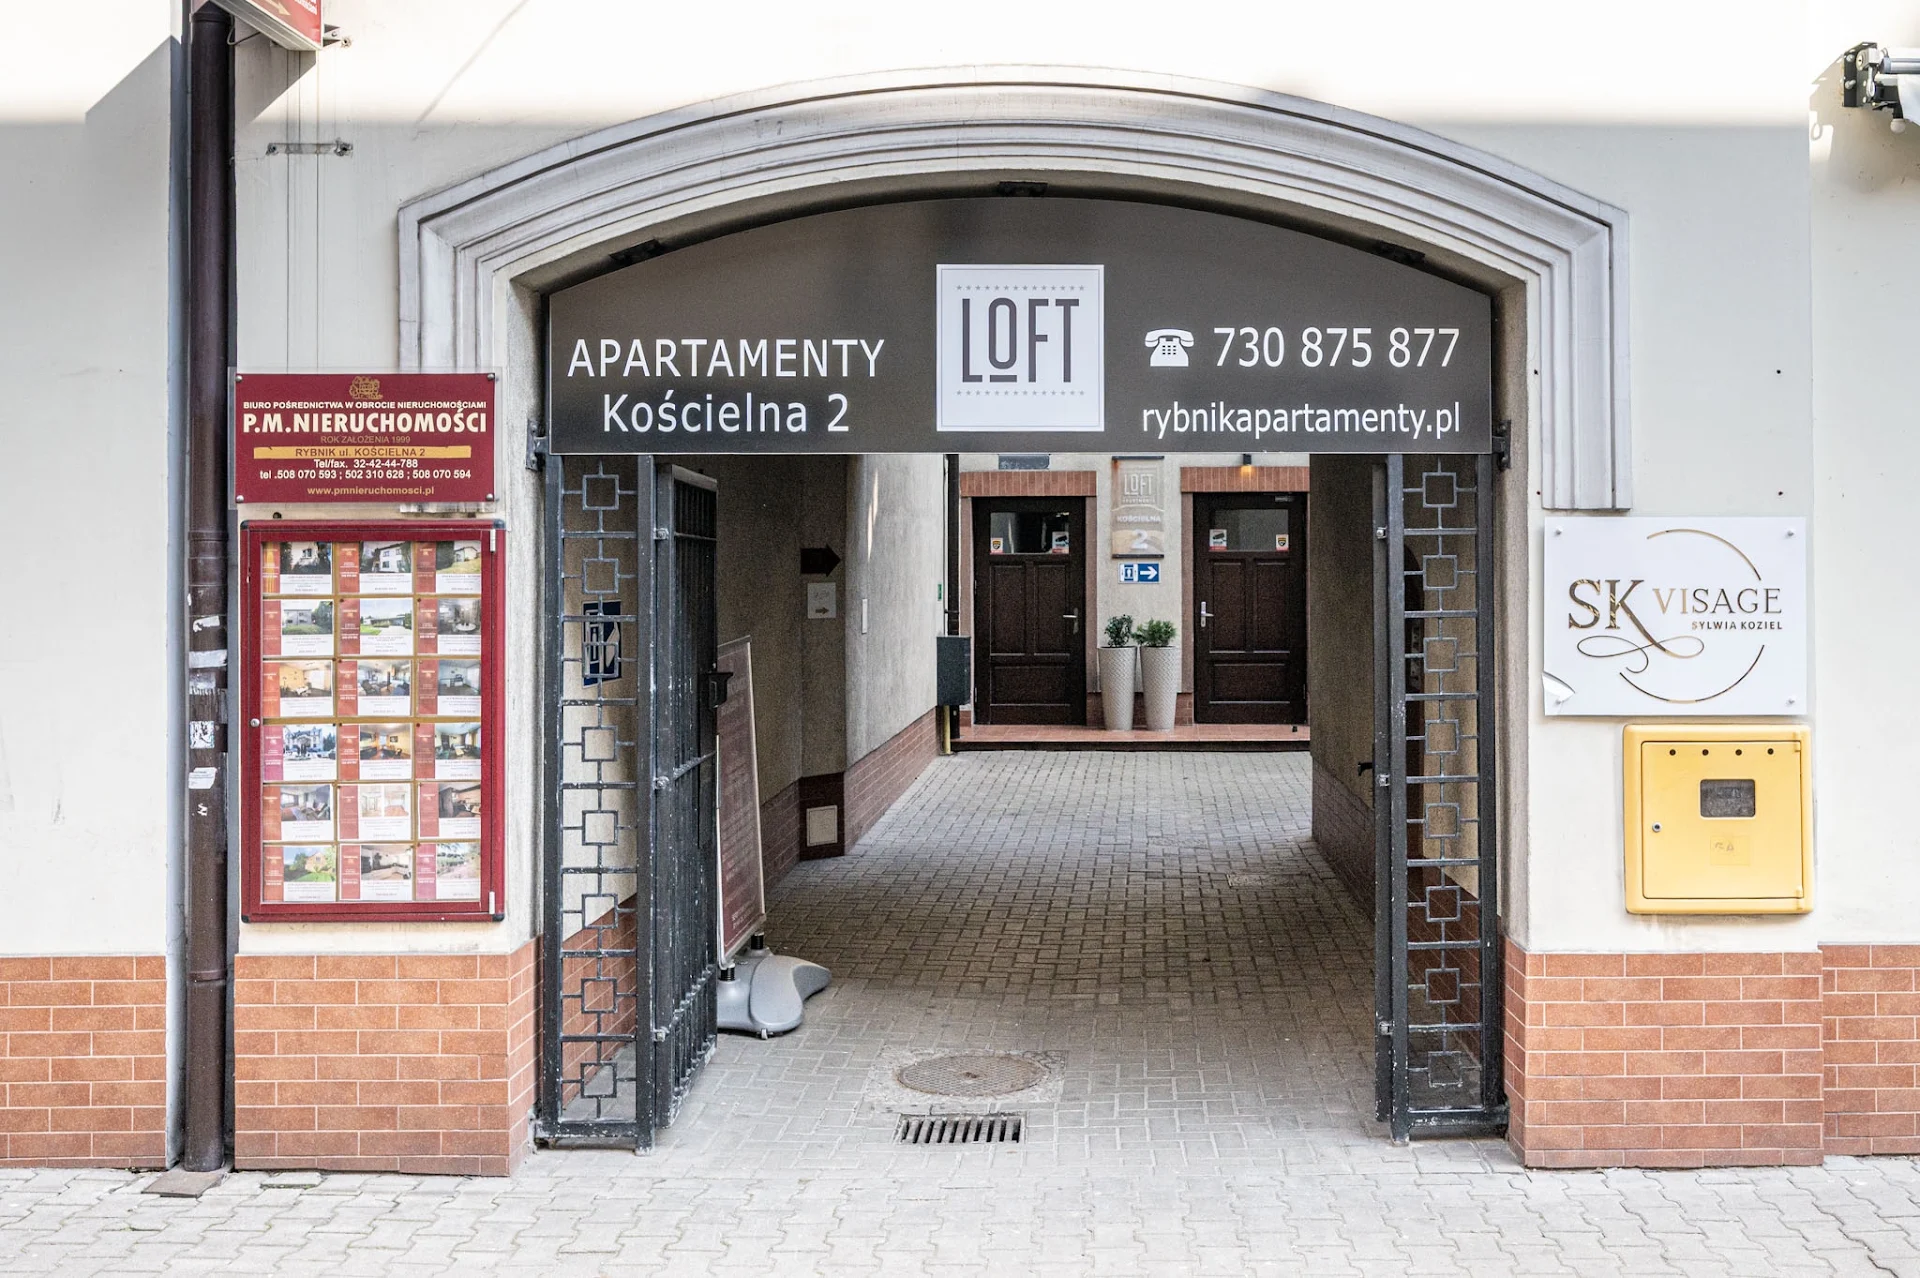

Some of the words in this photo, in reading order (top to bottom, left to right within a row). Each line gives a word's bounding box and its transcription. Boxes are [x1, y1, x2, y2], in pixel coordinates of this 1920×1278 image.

[962, 297, 1080, 383] LOFT
[1214, 327, 1285, 368] 730
[1301, 327, 1372, 368] 875
[1389, 327, 1460, 368] 877
[568, 339, 885, 378] APARTAMENTY
[273, 401, 343, 409] POŚREDNICTWA
[397, 401, 486, 409] NIERUCHOMOŚCIAMI
[603, 390, 807, 432] Kościelna
[827, 393, 849, 432] 2
[243, 408, 486, 433] P.M.NIERUCHOMOŚCI
[1142, 402, 1461, 439] rybnikapartamenty.pl
[341, 435, 390, 443] ZAŁOŻENIA
[295, 449, 335, 457] RYBNIK
[339, 449, 351, 457] ul.
[355, 447, 417, 457] KOŚCIELNA
[314, 459, 348, 468] Tel/fax.
[354, 460, 418, 468] 32-42-44-788
[260, 470, 272, 479] tel
[298, 470, 315, 479] 070
[317, 470, 337, 479] 593
[345, 470, 363, 479] 502
[366, 470, 384, 479] 310
[386, 470, 404, 479] 628
[412, 470, 430, 479] 508
[433, 470, 450, 479] 070
[453, 470, 471, 479] 594
[1124, 474, 1154, 496] LOFT
[307, 486, 435, 496] www.pmnieruchomosci.pl
[1131, 529, 1148, 549] 2
[1568, 579, 1667, 653] SK
[1652, 587, 1783, 615] VISAGE
[1692, 621, 1738, 630] SYLWIA
[1741, 621, 1783, 630] KOZIEL
